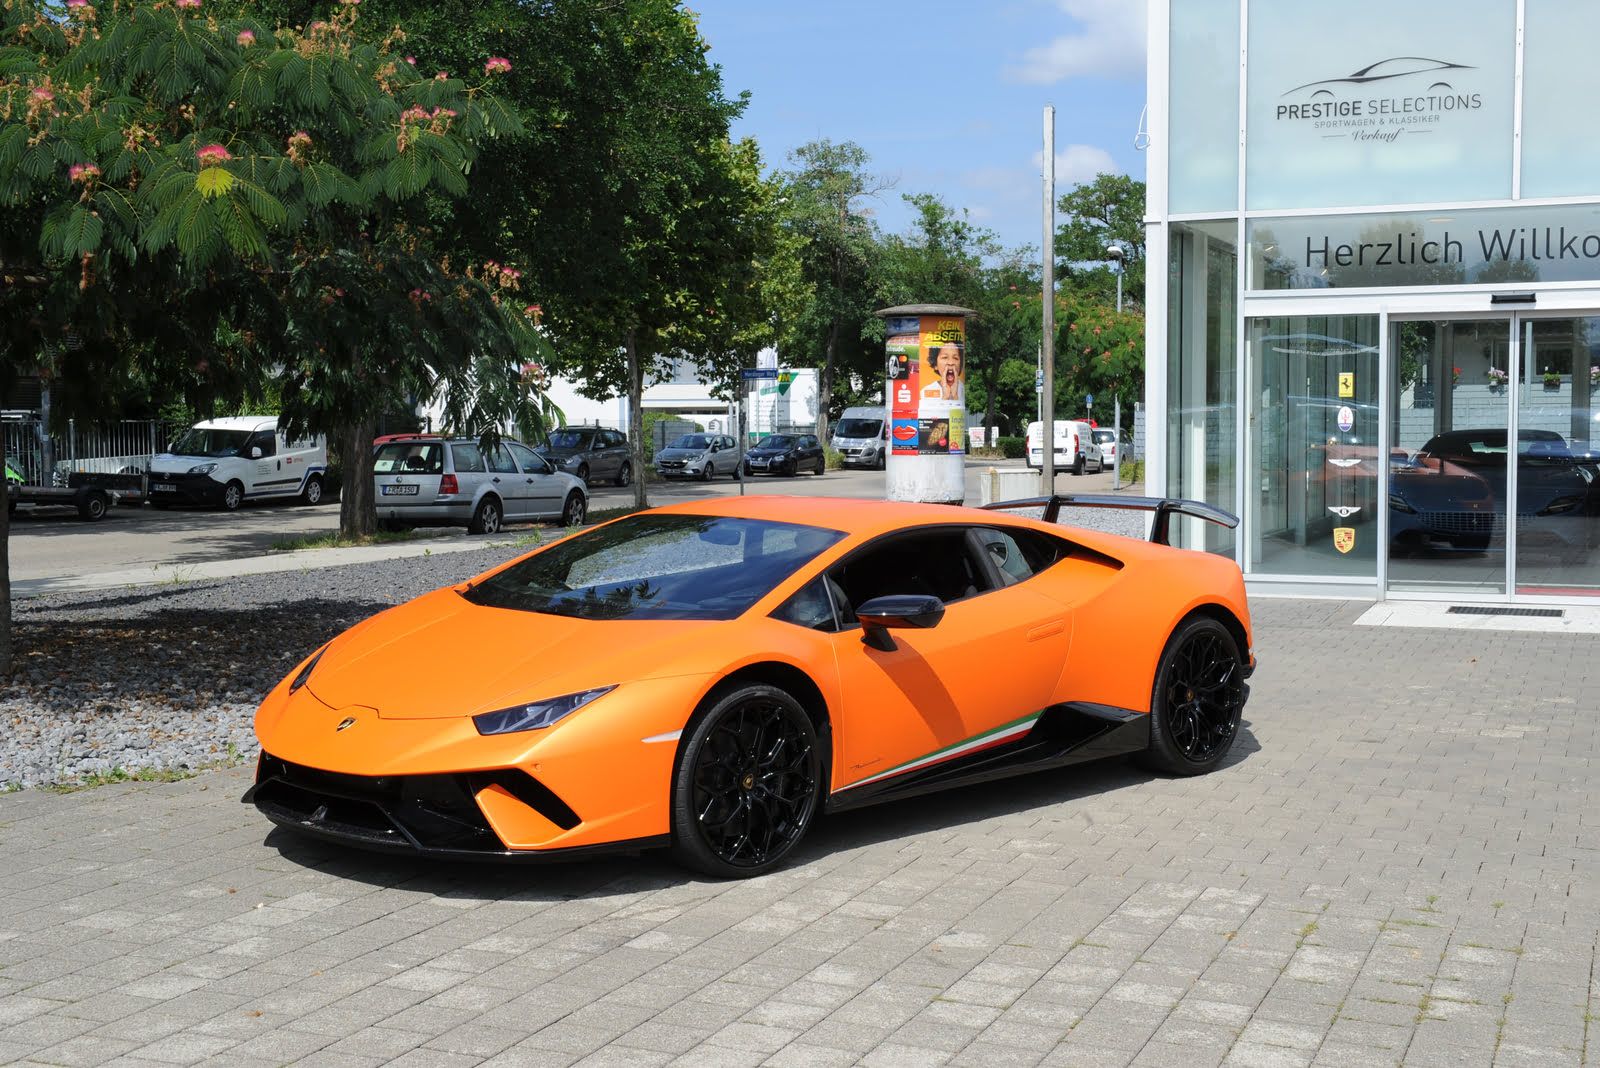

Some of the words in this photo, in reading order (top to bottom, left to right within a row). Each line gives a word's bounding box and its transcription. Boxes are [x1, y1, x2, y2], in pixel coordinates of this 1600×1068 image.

[1276, 101, 1362, 120] PRESTIGE
[1368, 94, 1482, 115] SELECTIONS
[1314, 118, 1376, 129] SPORTWAGEN
[1388, 114, 1440, 125] KLASSIKER
[1351, 127, 1404, 143] Verkauf
[1306, 231, 1463, 267] Herzlich
[1478, 226, 1600, 262] Willko
[938, 320, 961, 331] KEIN
